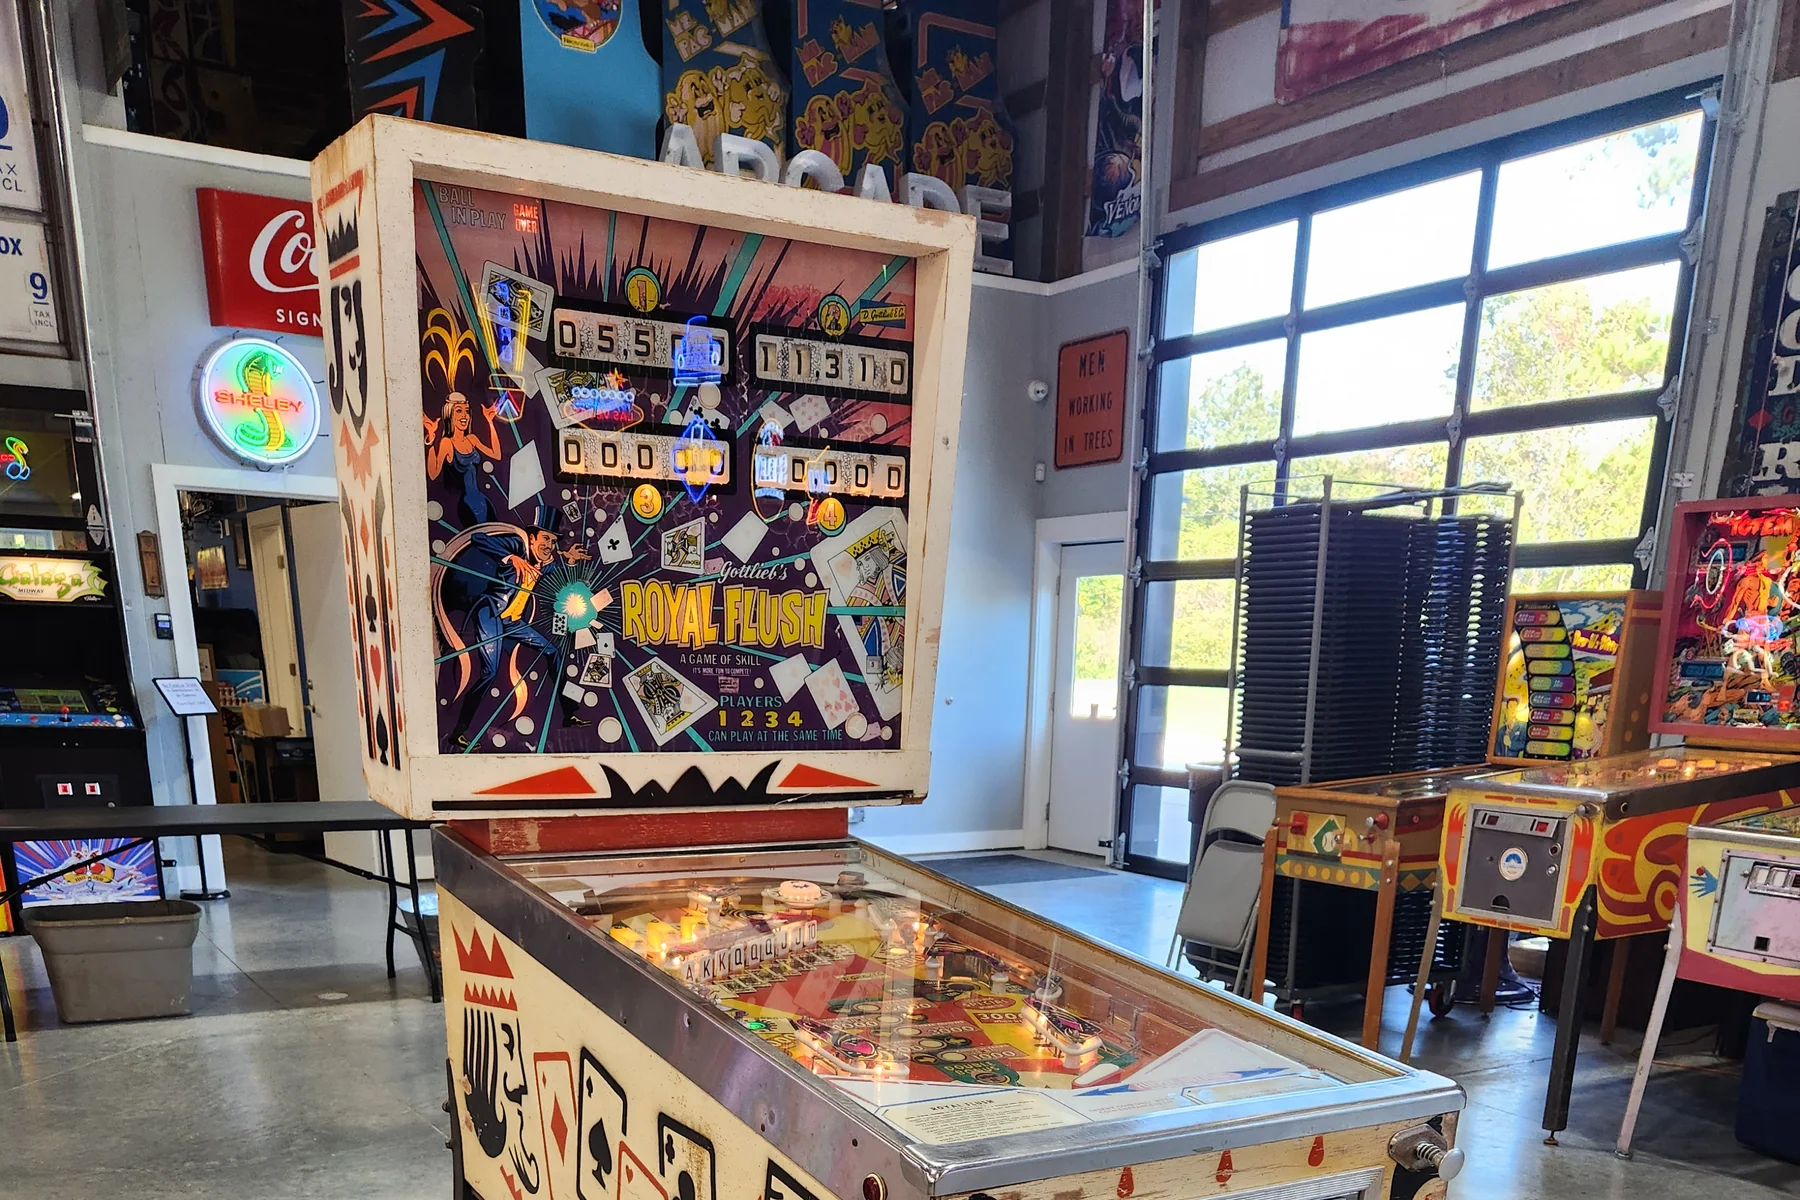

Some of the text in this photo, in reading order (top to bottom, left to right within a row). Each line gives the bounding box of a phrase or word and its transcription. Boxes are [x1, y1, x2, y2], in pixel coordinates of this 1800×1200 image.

[675, 25, 713, 62] PAC
[439, 186, 475, 207] BALL
[452, 207, 507, 231] IN PLAY
[513, 203, 538, 219] GAME
[515, 219, 538, 234] OVER
[29, 272, 48, 300] 9
[33, 309, 51, 319] TAX
[1079, 350, 1106, 378] MEN
[214, 389, 304, 414] SHELBY
[1068, 391, 1113, 417] WORKING
[1064, 429, 1114, 454] IN TREES
[1729, 514, 1794, 537] TOTEM
[717, 560, 788, 584] Gottlieb's
[620, 578, 830, 651] ROYAL FLUSH
[680, 653, 762, 667] A GAME OF SKILL
[702, 667, 714, 675] MORE
[715, 667, 725, 675] FUN
[720, 695, 782, 708] PLAYERS
[719, 709, 803, 728] 1 2 3 4
[708, 729, 843, 743] CAN PLAY AT THE SAME TIME
[734, 947, 742, 965] Q
[750, 943, 758, 961] Q
[765, 938, 773, 956] Q
[973, 1050, 1016, 1060] 1000
[943, 1061, 994, 1072] DOUBLE
[931, 1099, 993, 1112] ROYAL FLUSH
